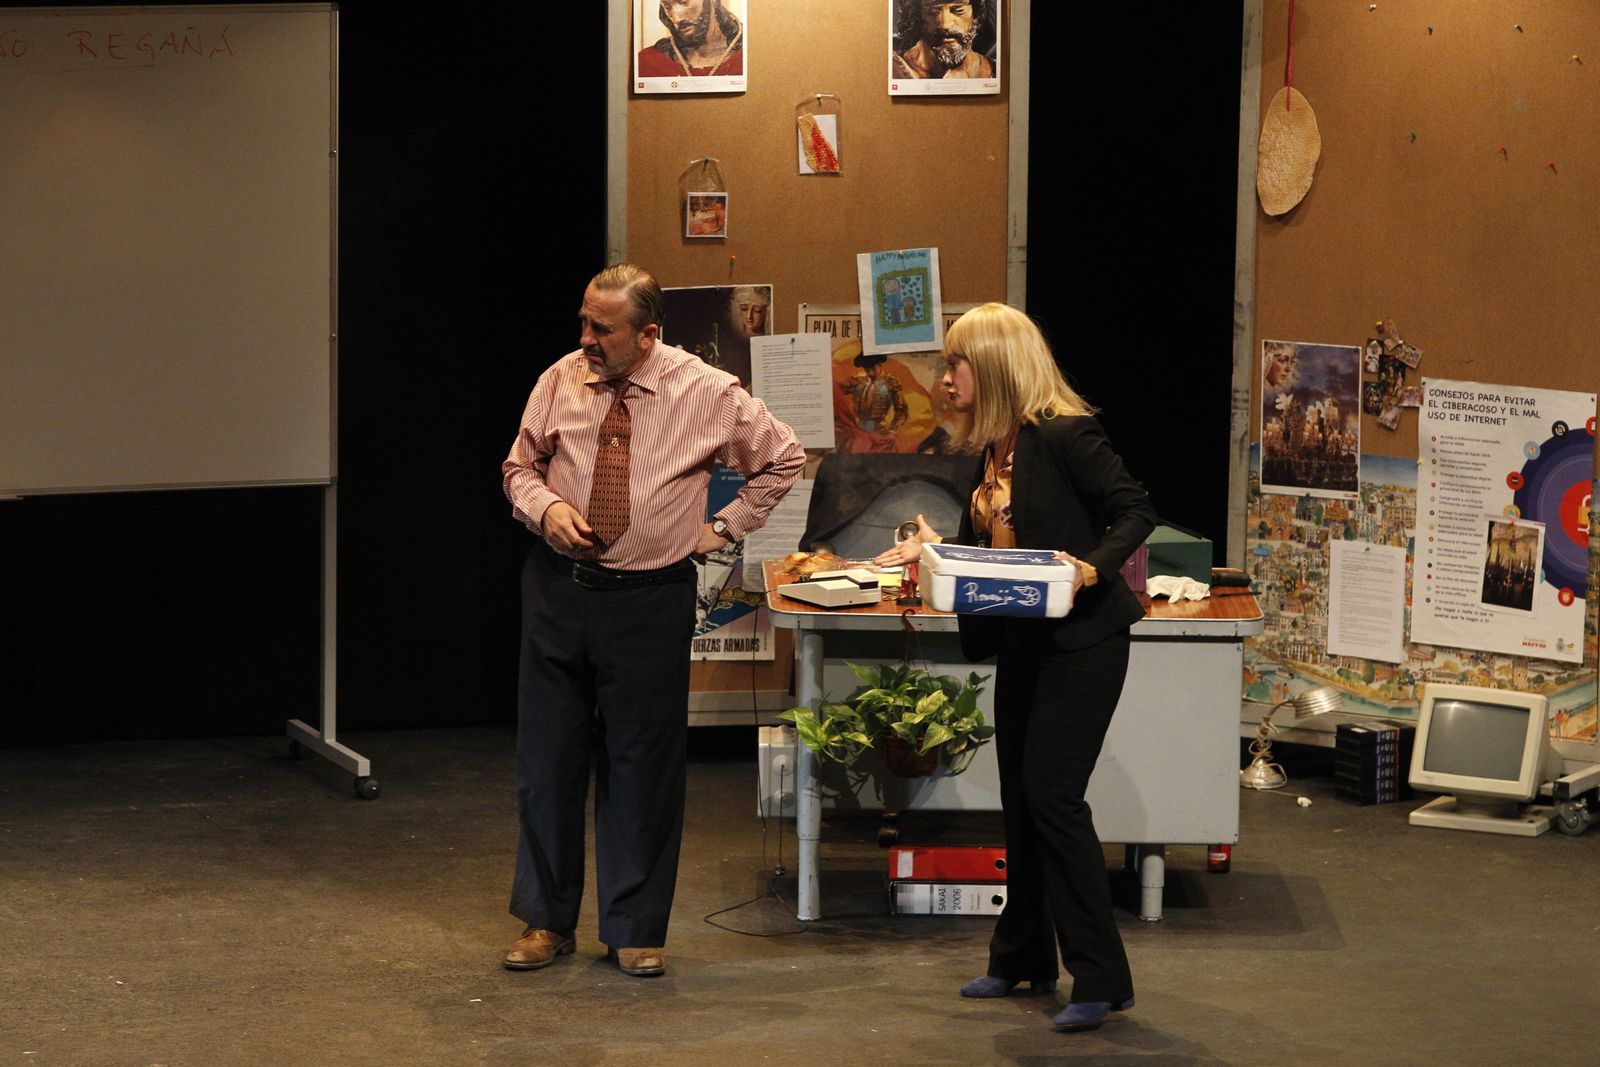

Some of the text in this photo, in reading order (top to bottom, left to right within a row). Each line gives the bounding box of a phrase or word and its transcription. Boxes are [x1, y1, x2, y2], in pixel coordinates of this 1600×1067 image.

[67, 24, 235, 60] REGAÑÁ
[814, 320, 837, 338] PLAZA
[842, 320, 851, 338] DE
[1429, 388, 1536, 407] CONSEJOS PARA EVITAR
[1428, 400, 1541, 419] EL CIBERACOSO Y EL MAL
[1428, 411, 1507, 426] USO DE INTERNET
[693, 638, 721, 653] UERZAS
[724, 638, 760, 653] ARMADAS
[938, 888, 947, 911] SAKAI
[953, 888, 961, 910] 2006
